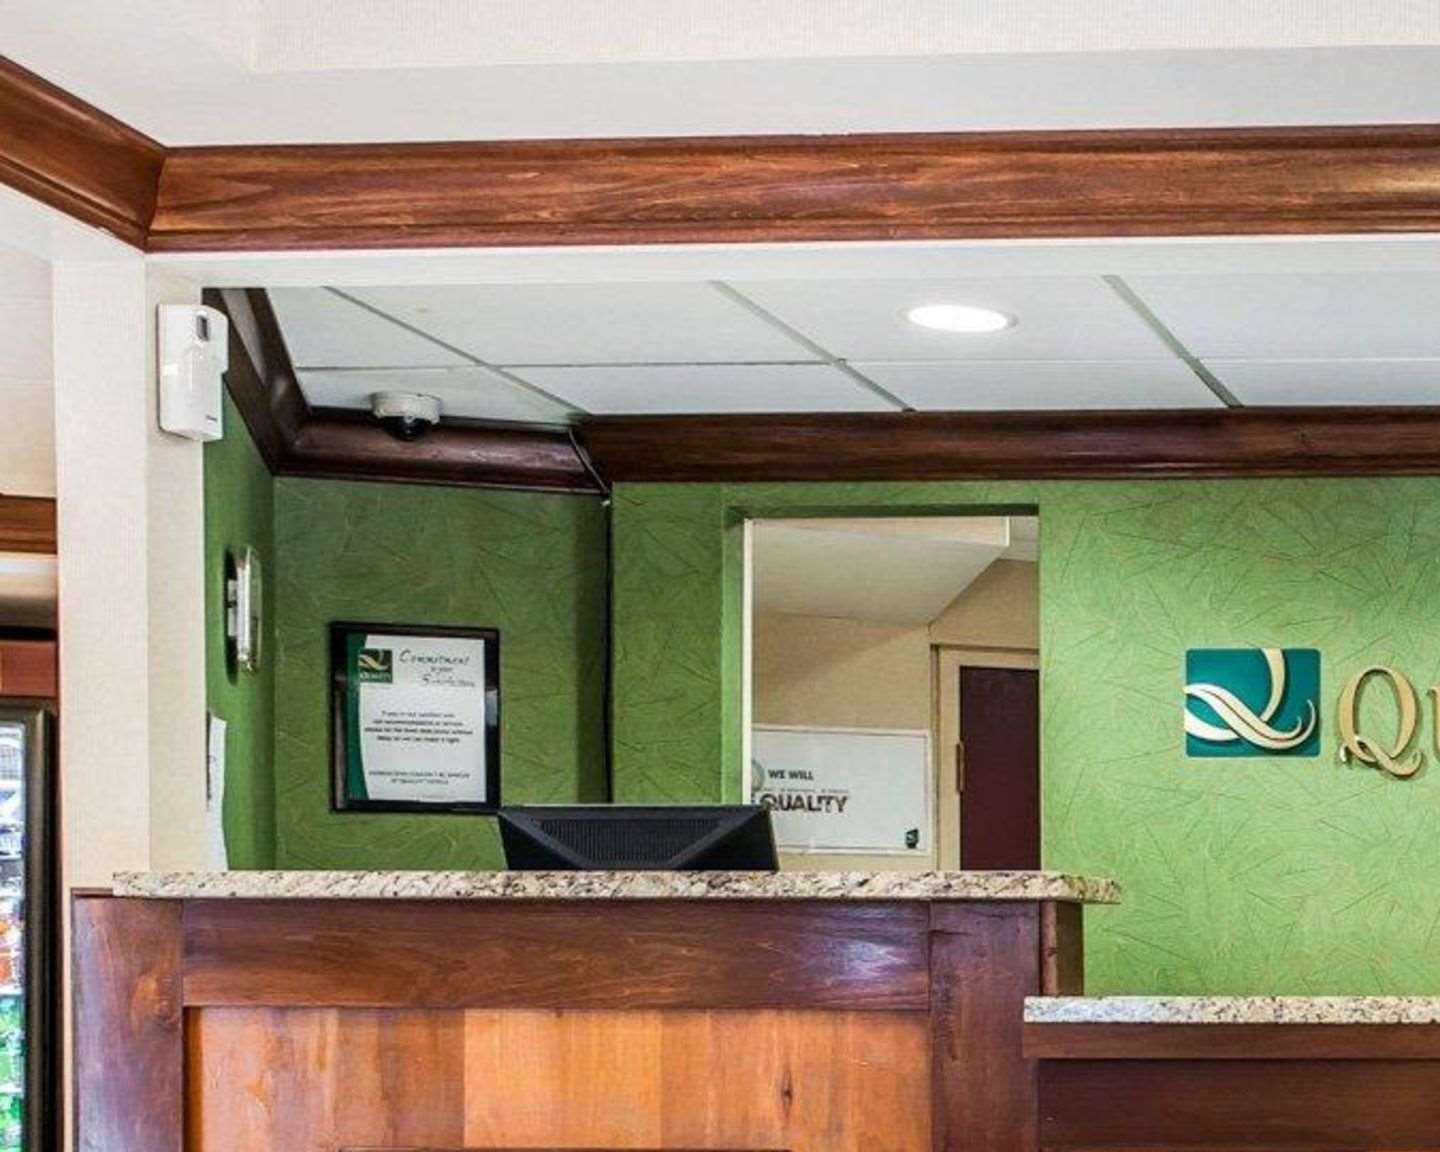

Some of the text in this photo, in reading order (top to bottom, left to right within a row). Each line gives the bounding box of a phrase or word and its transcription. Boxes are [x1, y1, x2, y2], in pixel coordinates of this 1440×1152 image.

[767, 769, 814, 781] WE WILL
[760, 793, 848, 813] QUALITY
